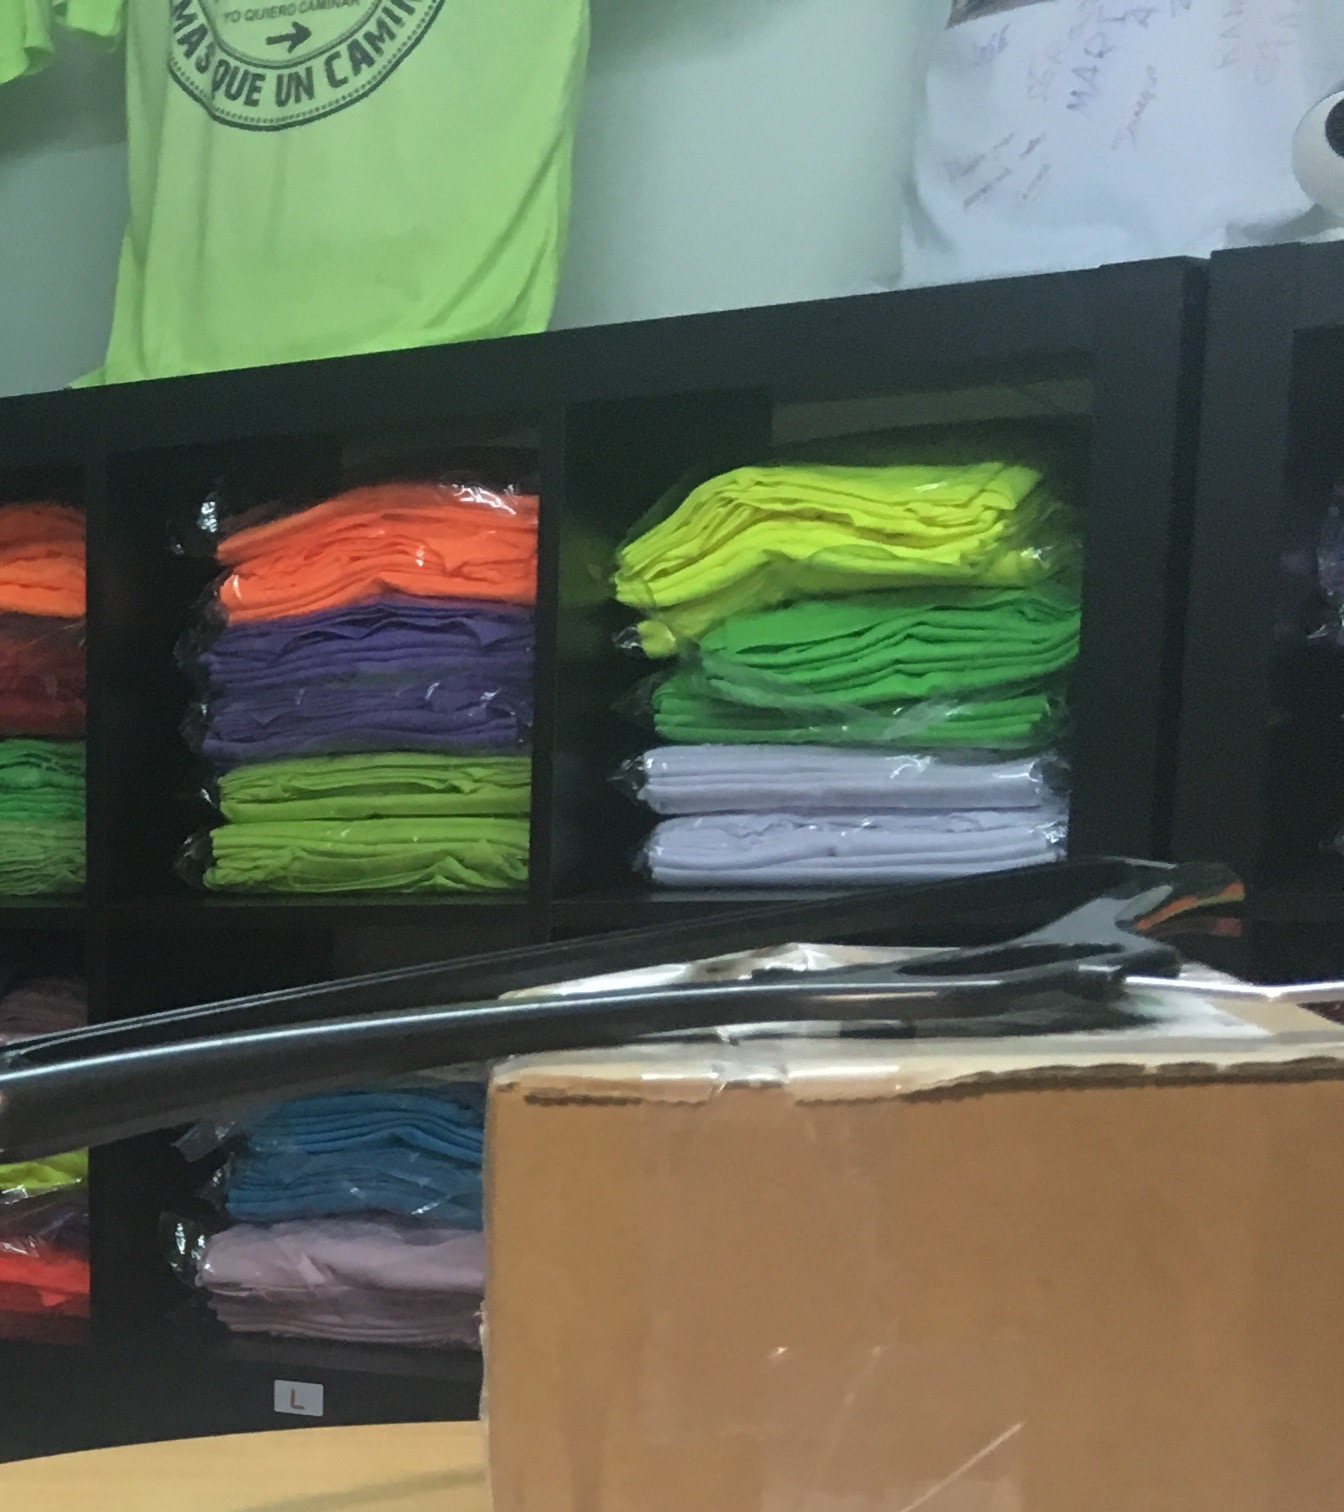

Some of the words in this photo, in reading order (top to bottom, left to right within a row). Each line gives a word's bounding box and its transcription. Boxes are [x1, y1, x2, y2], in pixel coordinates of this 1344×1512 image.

[244, 4, 297, 21] QUIERO
[212, 58, 266, 108] QUE
[275, 66, 315, 108] UN
[290, 1388, 305, 1410] L
